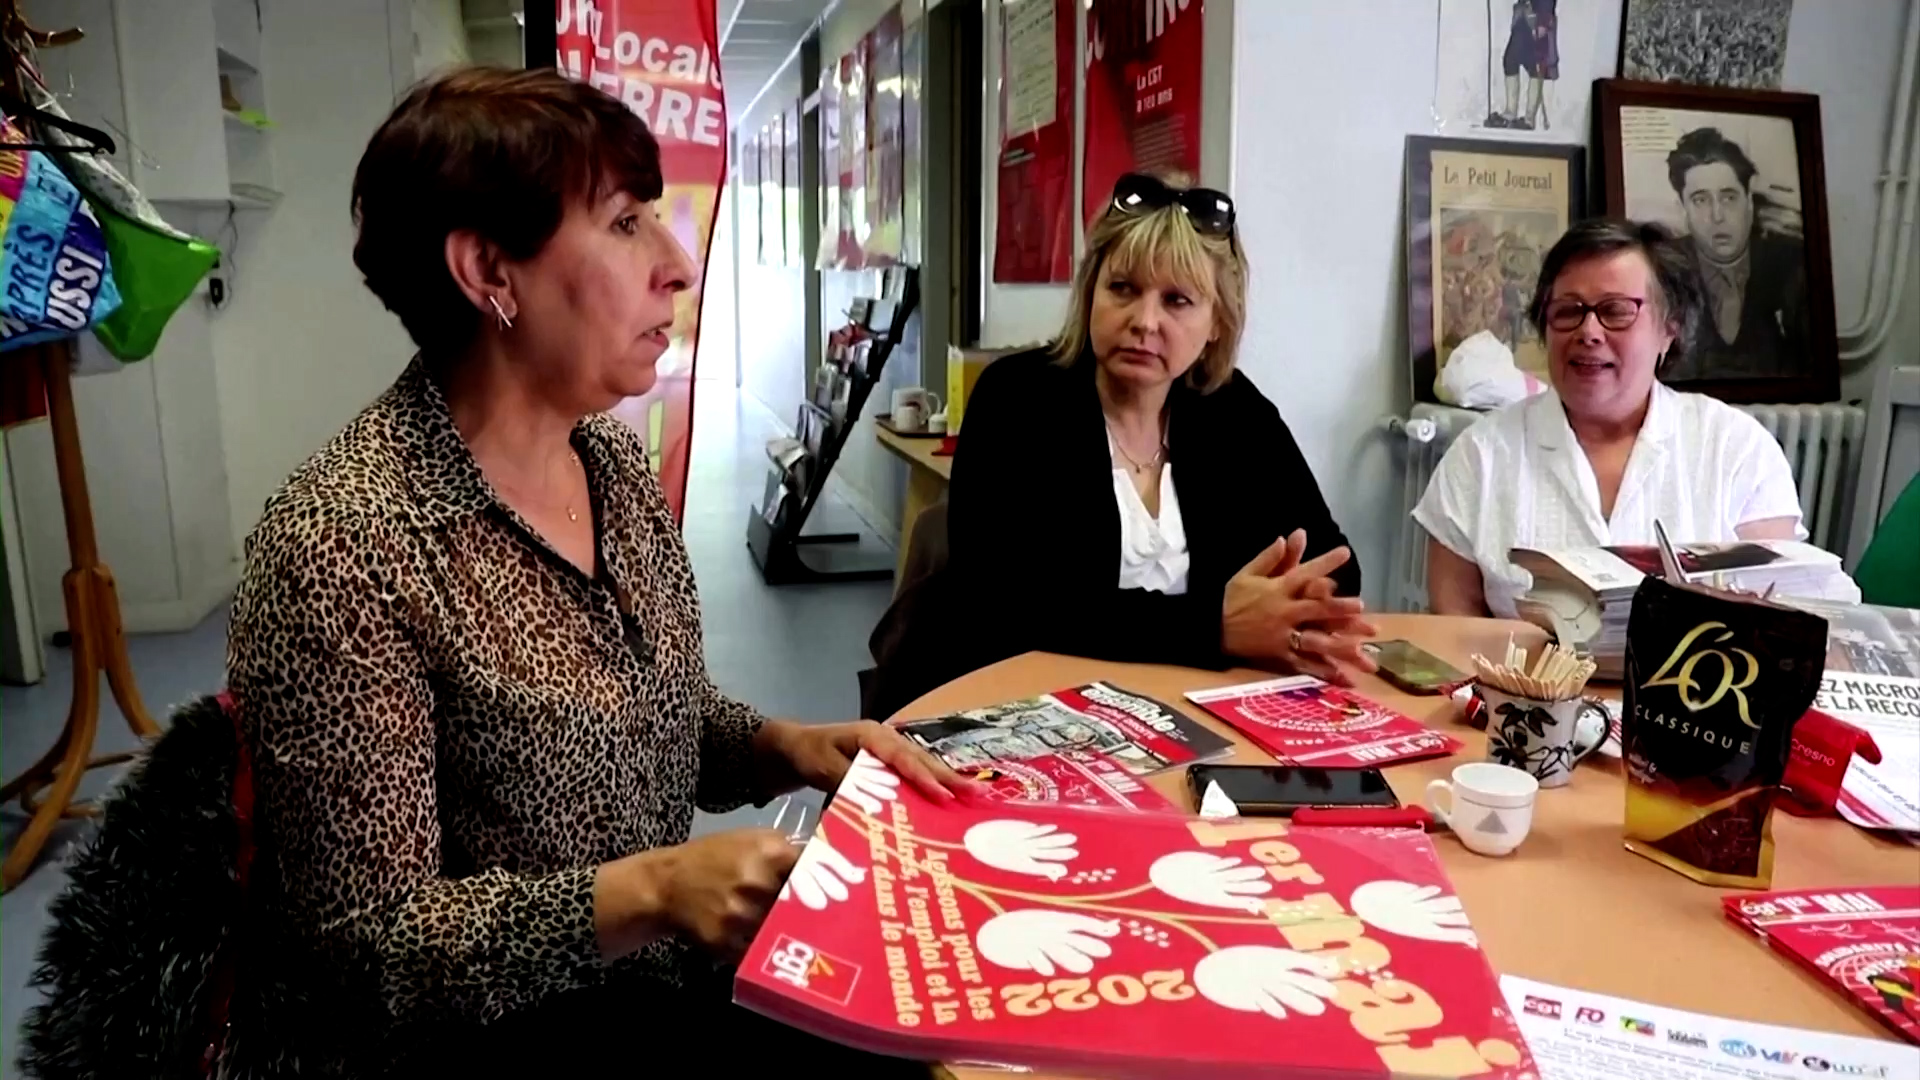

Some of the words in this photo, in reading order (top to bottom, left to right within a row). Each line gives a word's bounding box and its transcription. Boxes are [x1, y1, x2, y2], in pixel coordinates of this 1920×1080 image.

[1148, 65, 1163, 87] CGT
[1157, 88, 1173, 105] ans
[1443, 165, 1460, 185] Le
[1467, 166, 1497, 187] Petit
[1503, 168, 1553, 190] Journal
[1640, 620, 1761, 730] L'OR
[1831, 696, 1863, 712] LA
[1634, 703, 1751, 755] CLASSIQUE
[872, 864, 899, 918] dans
[920, 848, 966, 930] Agissons
[1808, 892, 1887, 914] MAI
[880, 919, 905, 943] le
[904, 885, 950, 970] l'emploi
[772, 940, 816, 990] cgt
[940, 933, 983, 984] pour
[885, 945, 924, 1027] monde
[925, 973, 956, 997] et
[999, 968, 1197, 1018] 2022
[931, 1000, 961, 1025] la
[965, 986, 996, 1021] les
[1575, 1006, 1605, 1024] FO
